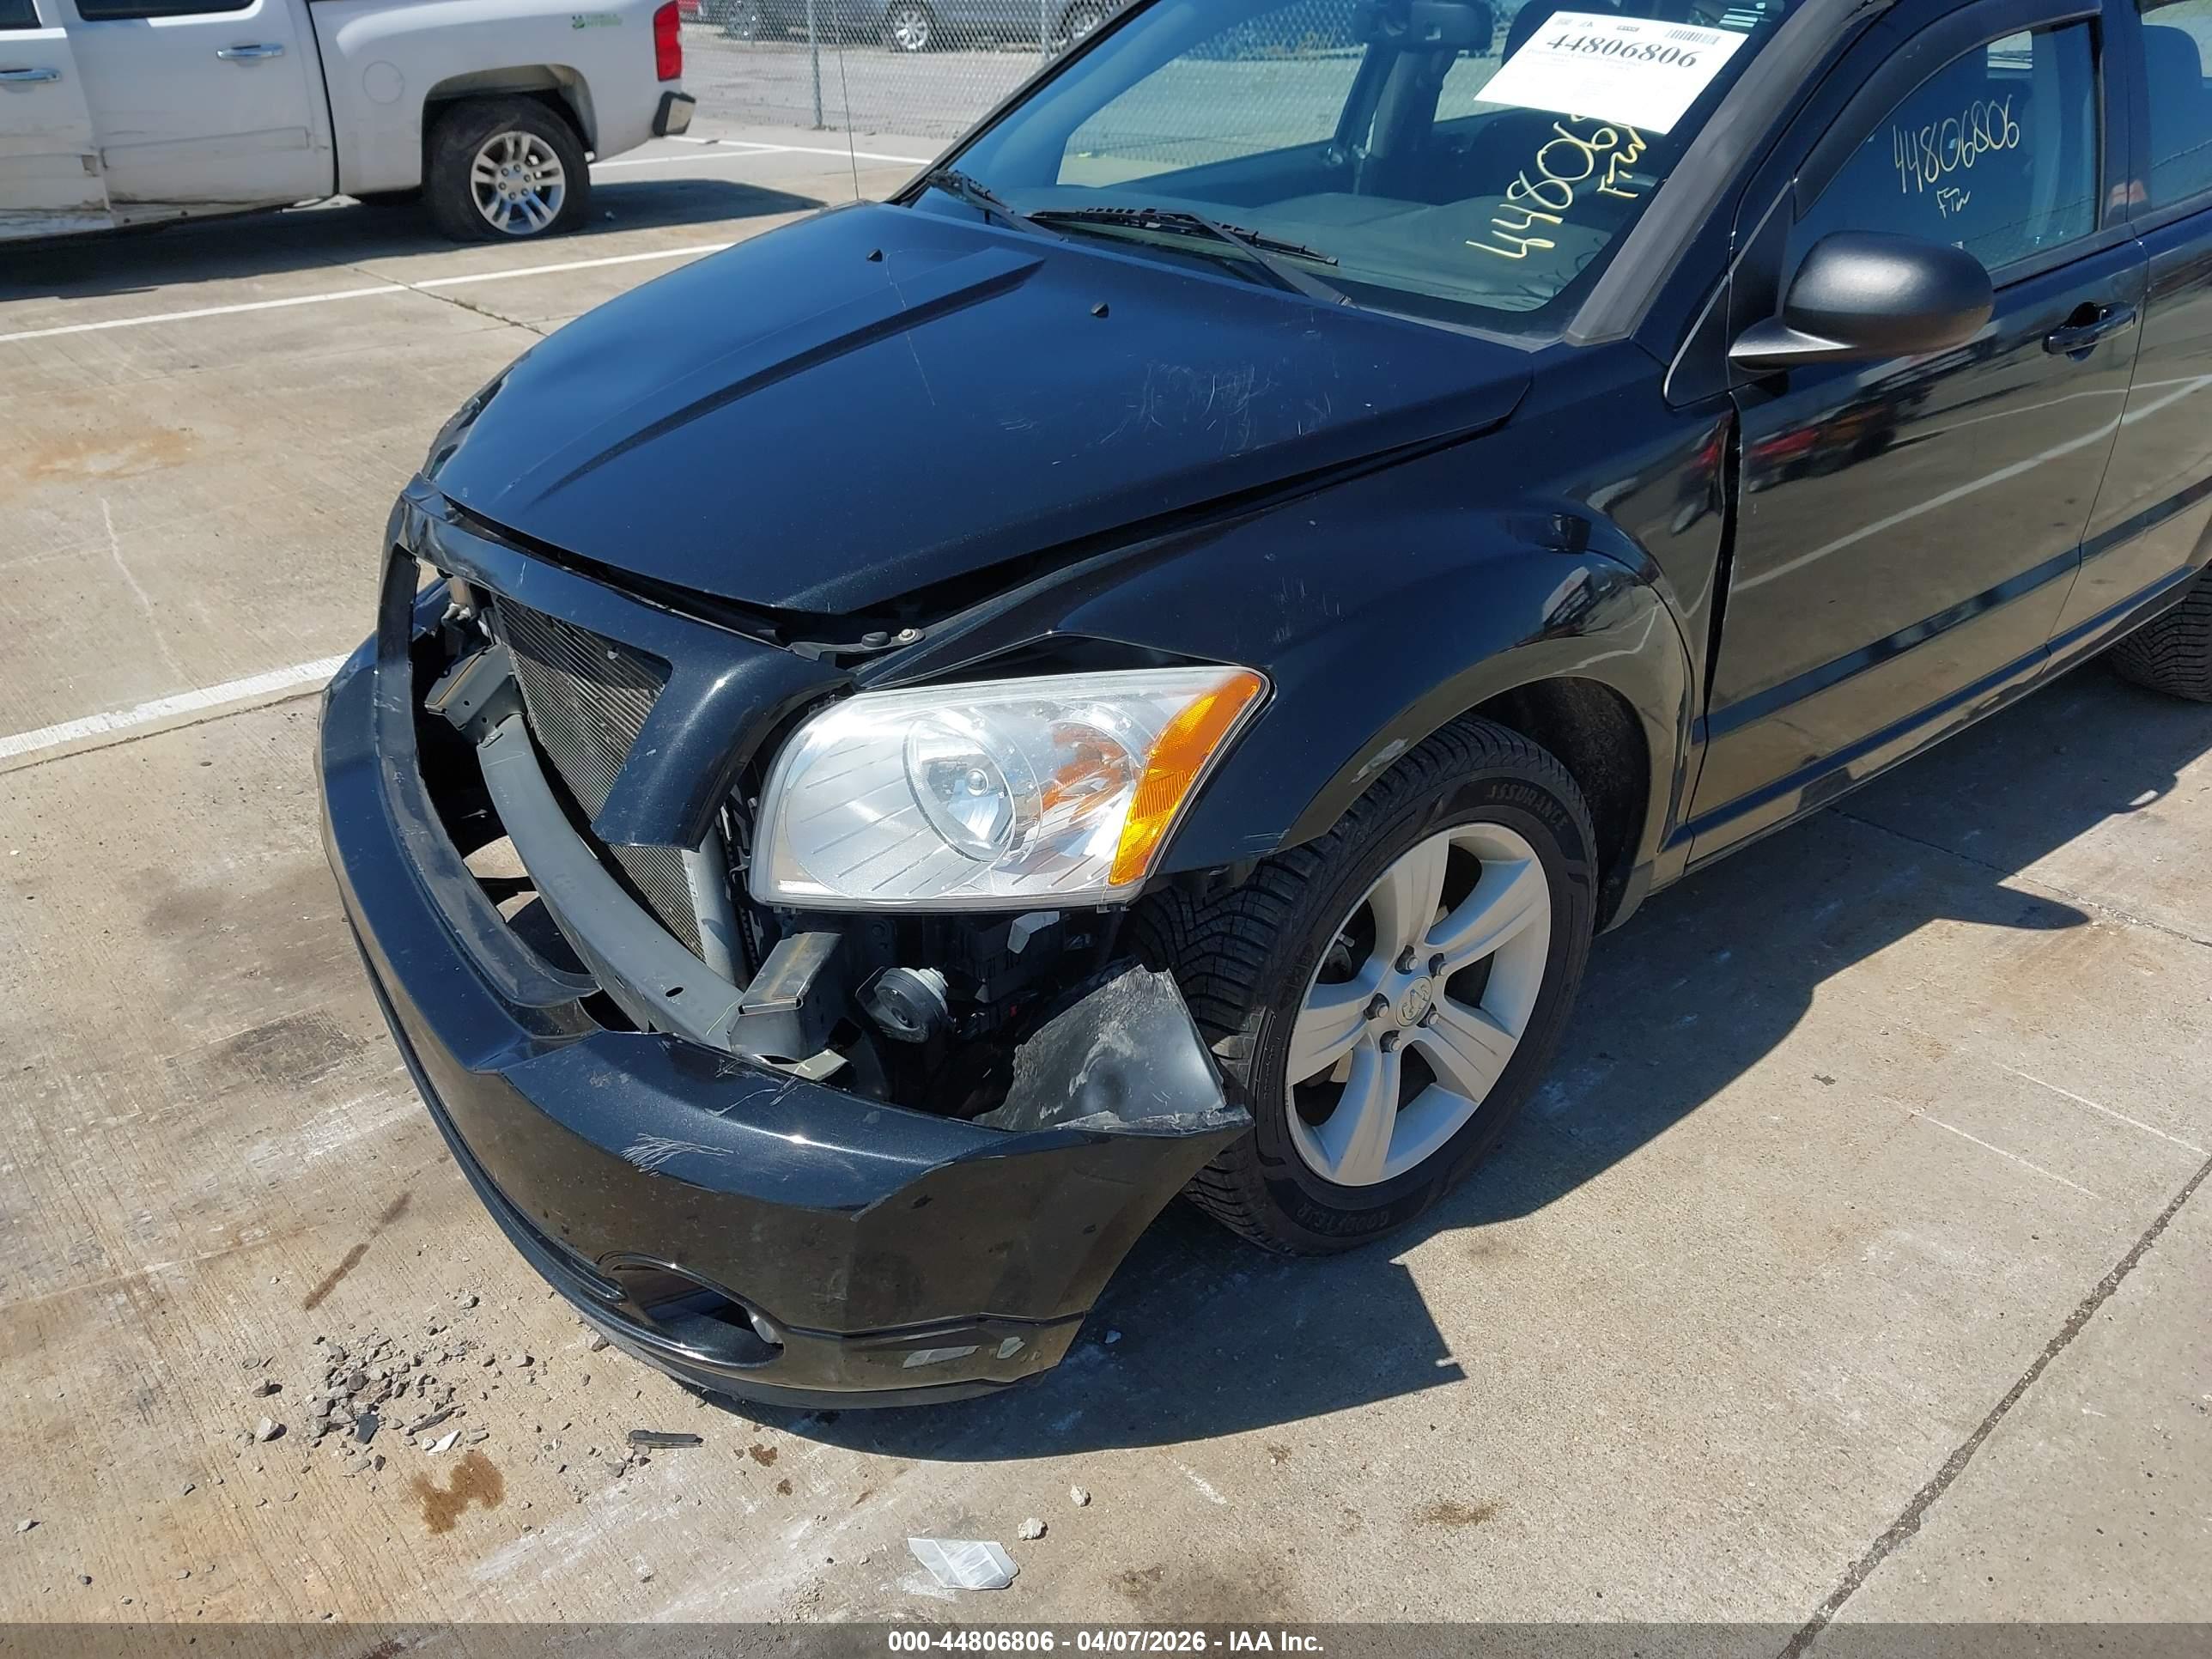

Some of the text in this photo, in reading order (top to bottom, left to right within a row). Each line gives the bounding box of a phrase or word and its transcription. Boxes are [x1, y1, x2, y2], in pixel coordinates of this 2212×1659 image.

[1547, 33, 1703, 68] 44806806
[1893, 94, 2020, 194] 44806806
[1484, 783, 1568, 831] ASSURANCE
